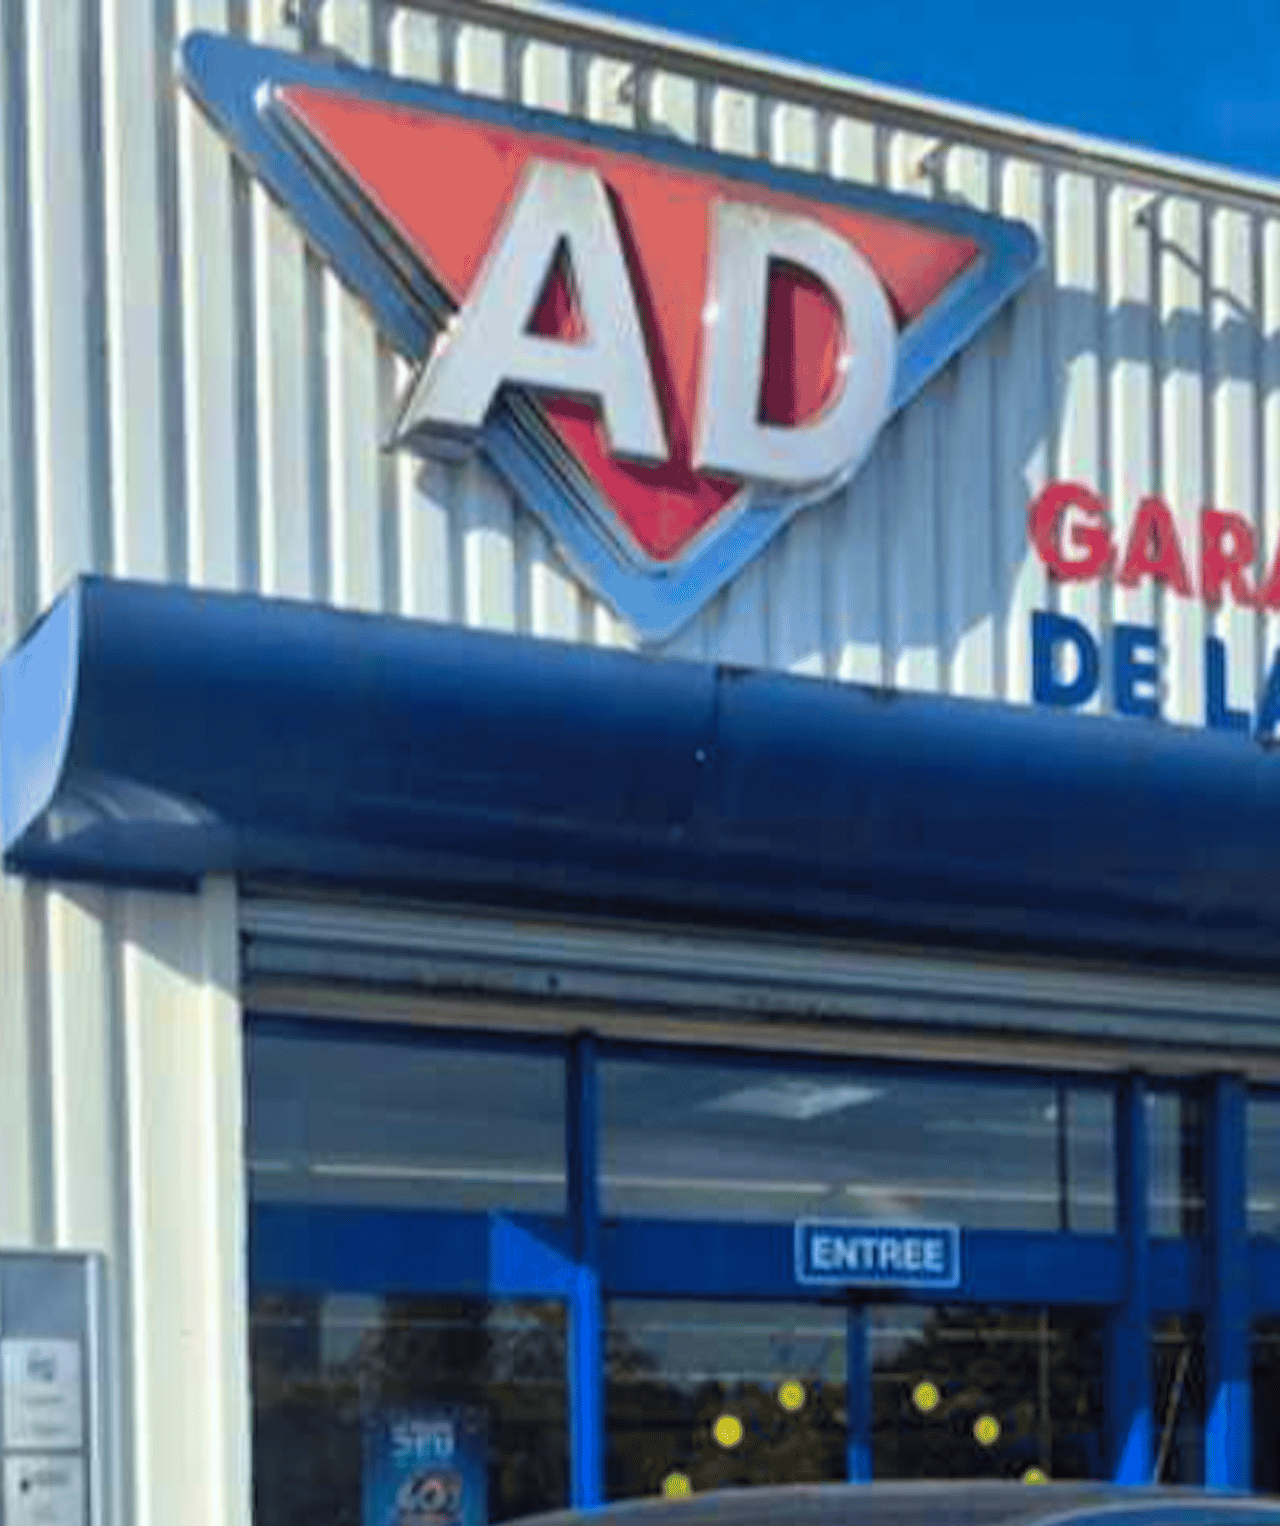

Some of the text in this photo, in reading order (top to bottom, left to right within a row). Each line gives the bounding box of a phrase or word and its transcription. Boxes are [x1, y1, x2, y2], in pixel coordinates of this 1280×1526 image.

[388, 156, 898, 486] AD
[1030, 609, 1162, 717] DE
[811, 1234, 945, 1274] ENTREE
